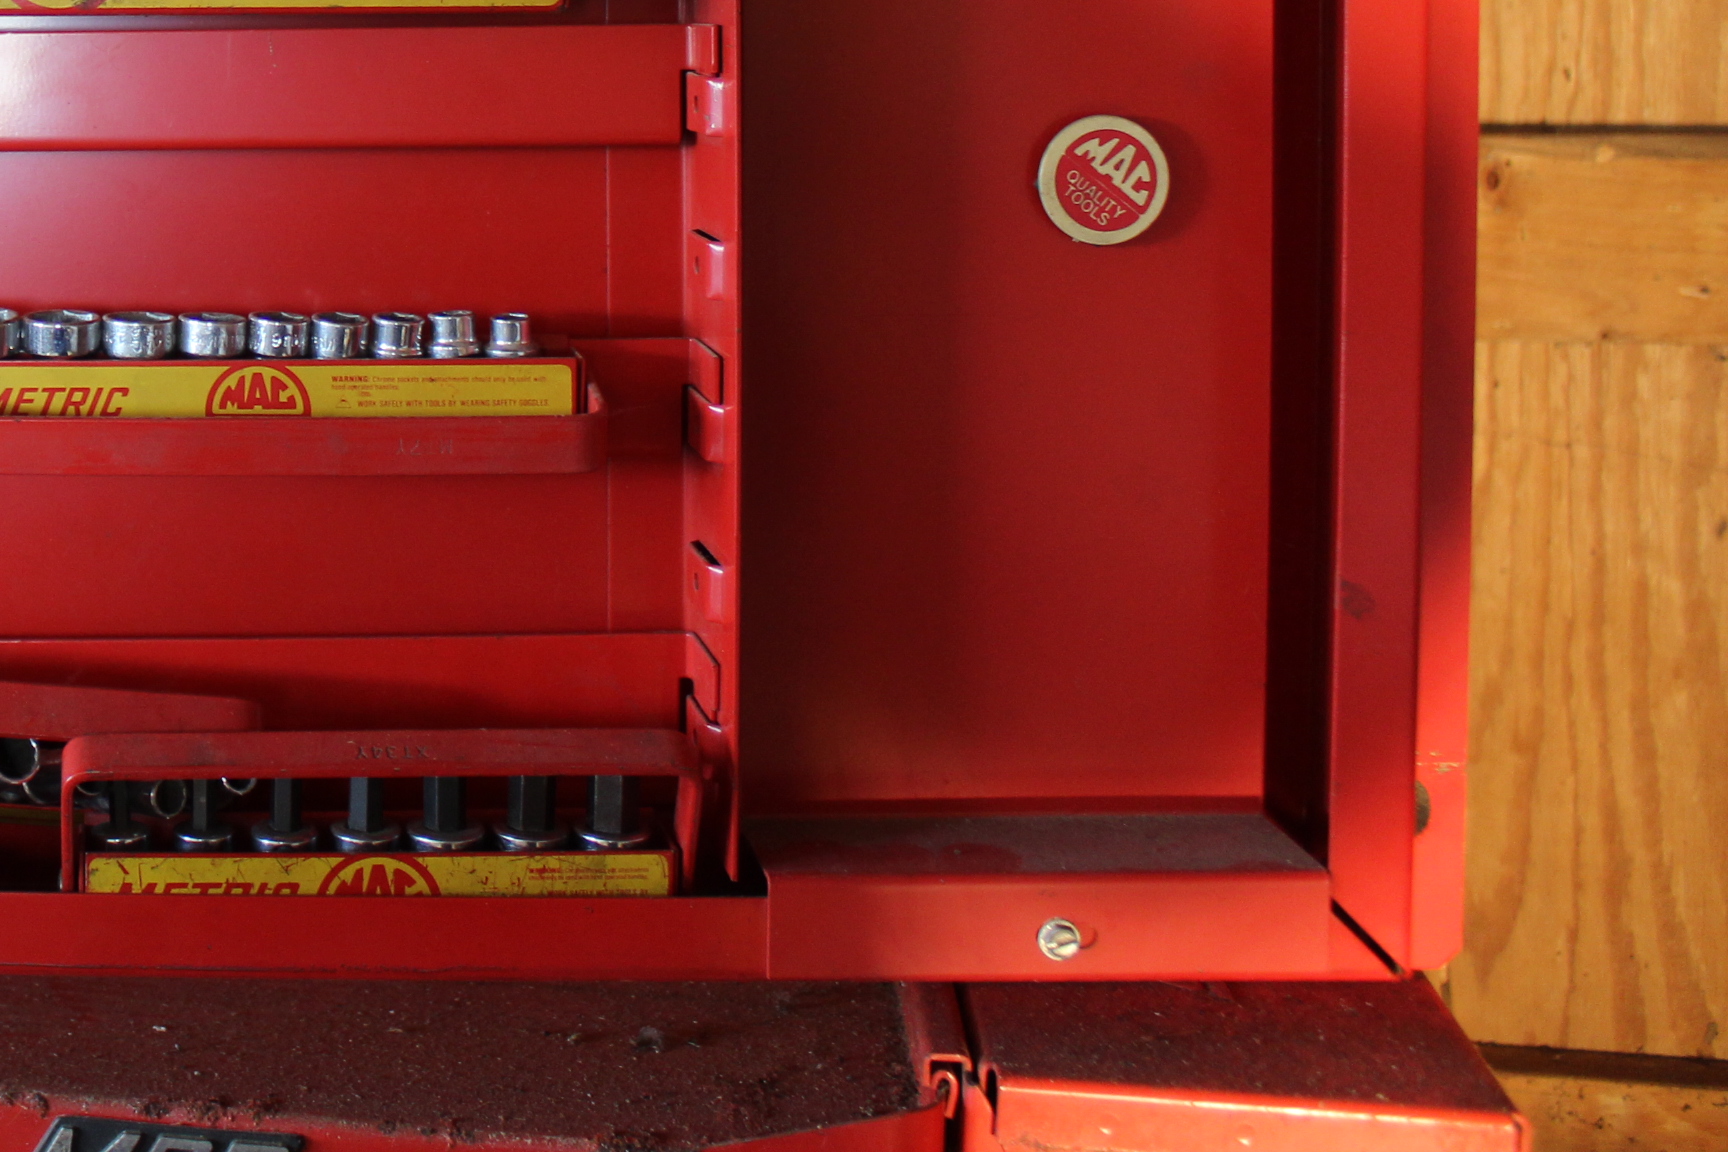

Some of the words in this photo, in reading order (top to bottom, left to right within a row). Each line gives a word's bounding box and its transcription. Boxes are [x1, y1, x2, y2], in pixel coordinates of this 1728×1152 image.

[1073, 137, 1152, 206] MAC
[1064, 186, 1111, 226] TOOLS
[1067, 170, 1127, 219] QUALITY
[219, 372, 298, 410] MAC
[331, 375, 369, 383] WARNING:
[358, 399, 376, 407] WORK
[380, 399, 403, 407] SAFELY
[406, 399, 422, 407] WITH
[425, 399, 446, 407] TOOLS
[448, 399, 457, 407] BY
[461, 399, 491, 407] WEARING
[492, 398, 517, 407] SAFETY
